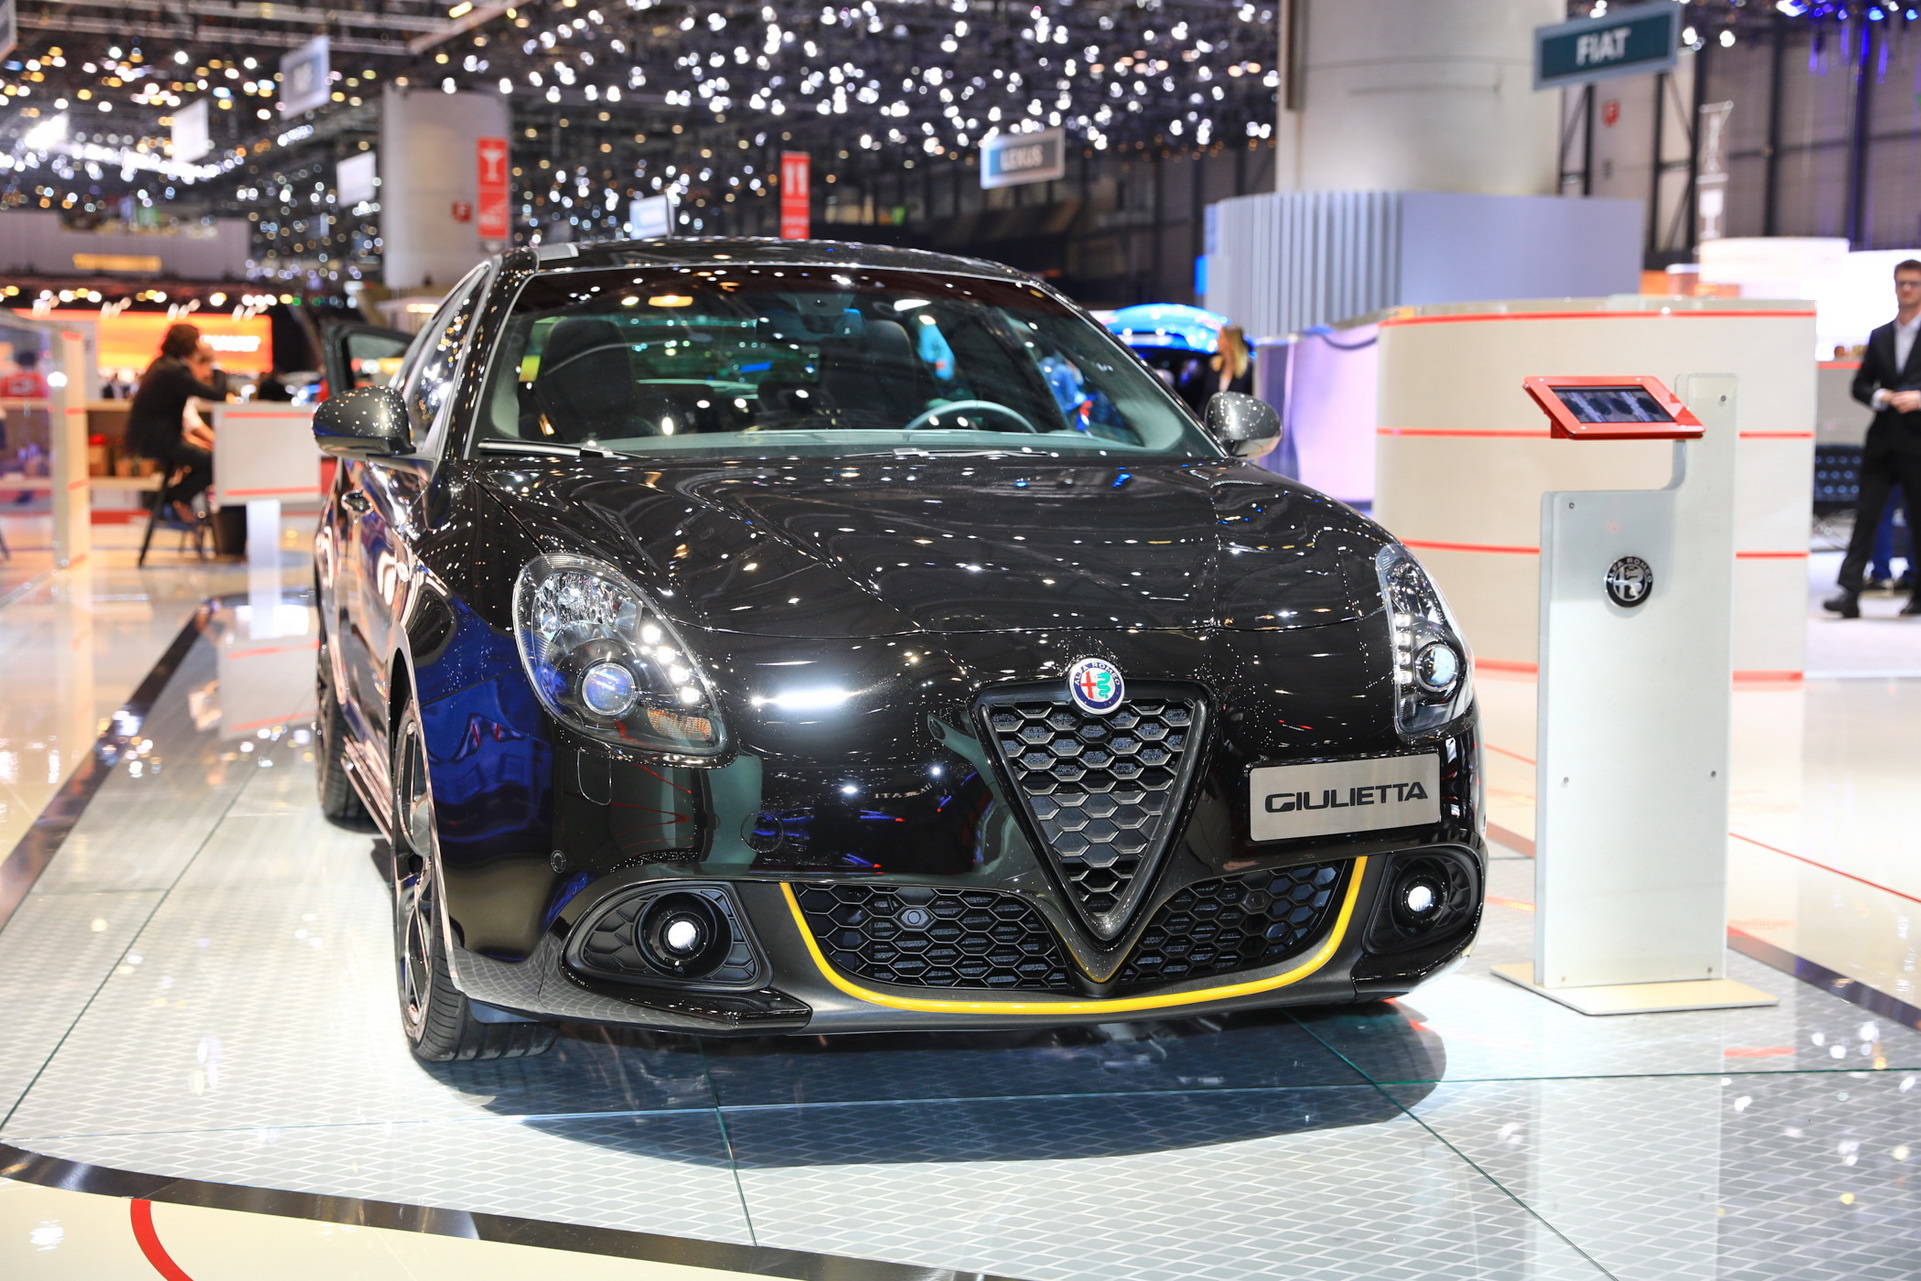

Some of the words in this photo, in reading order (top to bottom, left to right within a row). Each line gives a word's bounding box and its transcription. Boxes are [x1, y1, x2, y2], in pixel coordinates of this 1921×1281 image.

[1576, 27, 1631, 66] FIAT
[1626, 557, 1653, 583] ROMEO
[1073, 664, 1090, 686] ALFA
[1091, 661, 1121, 686] ROMEO
[1265, 781, 1428, 813] GIULIETTA
